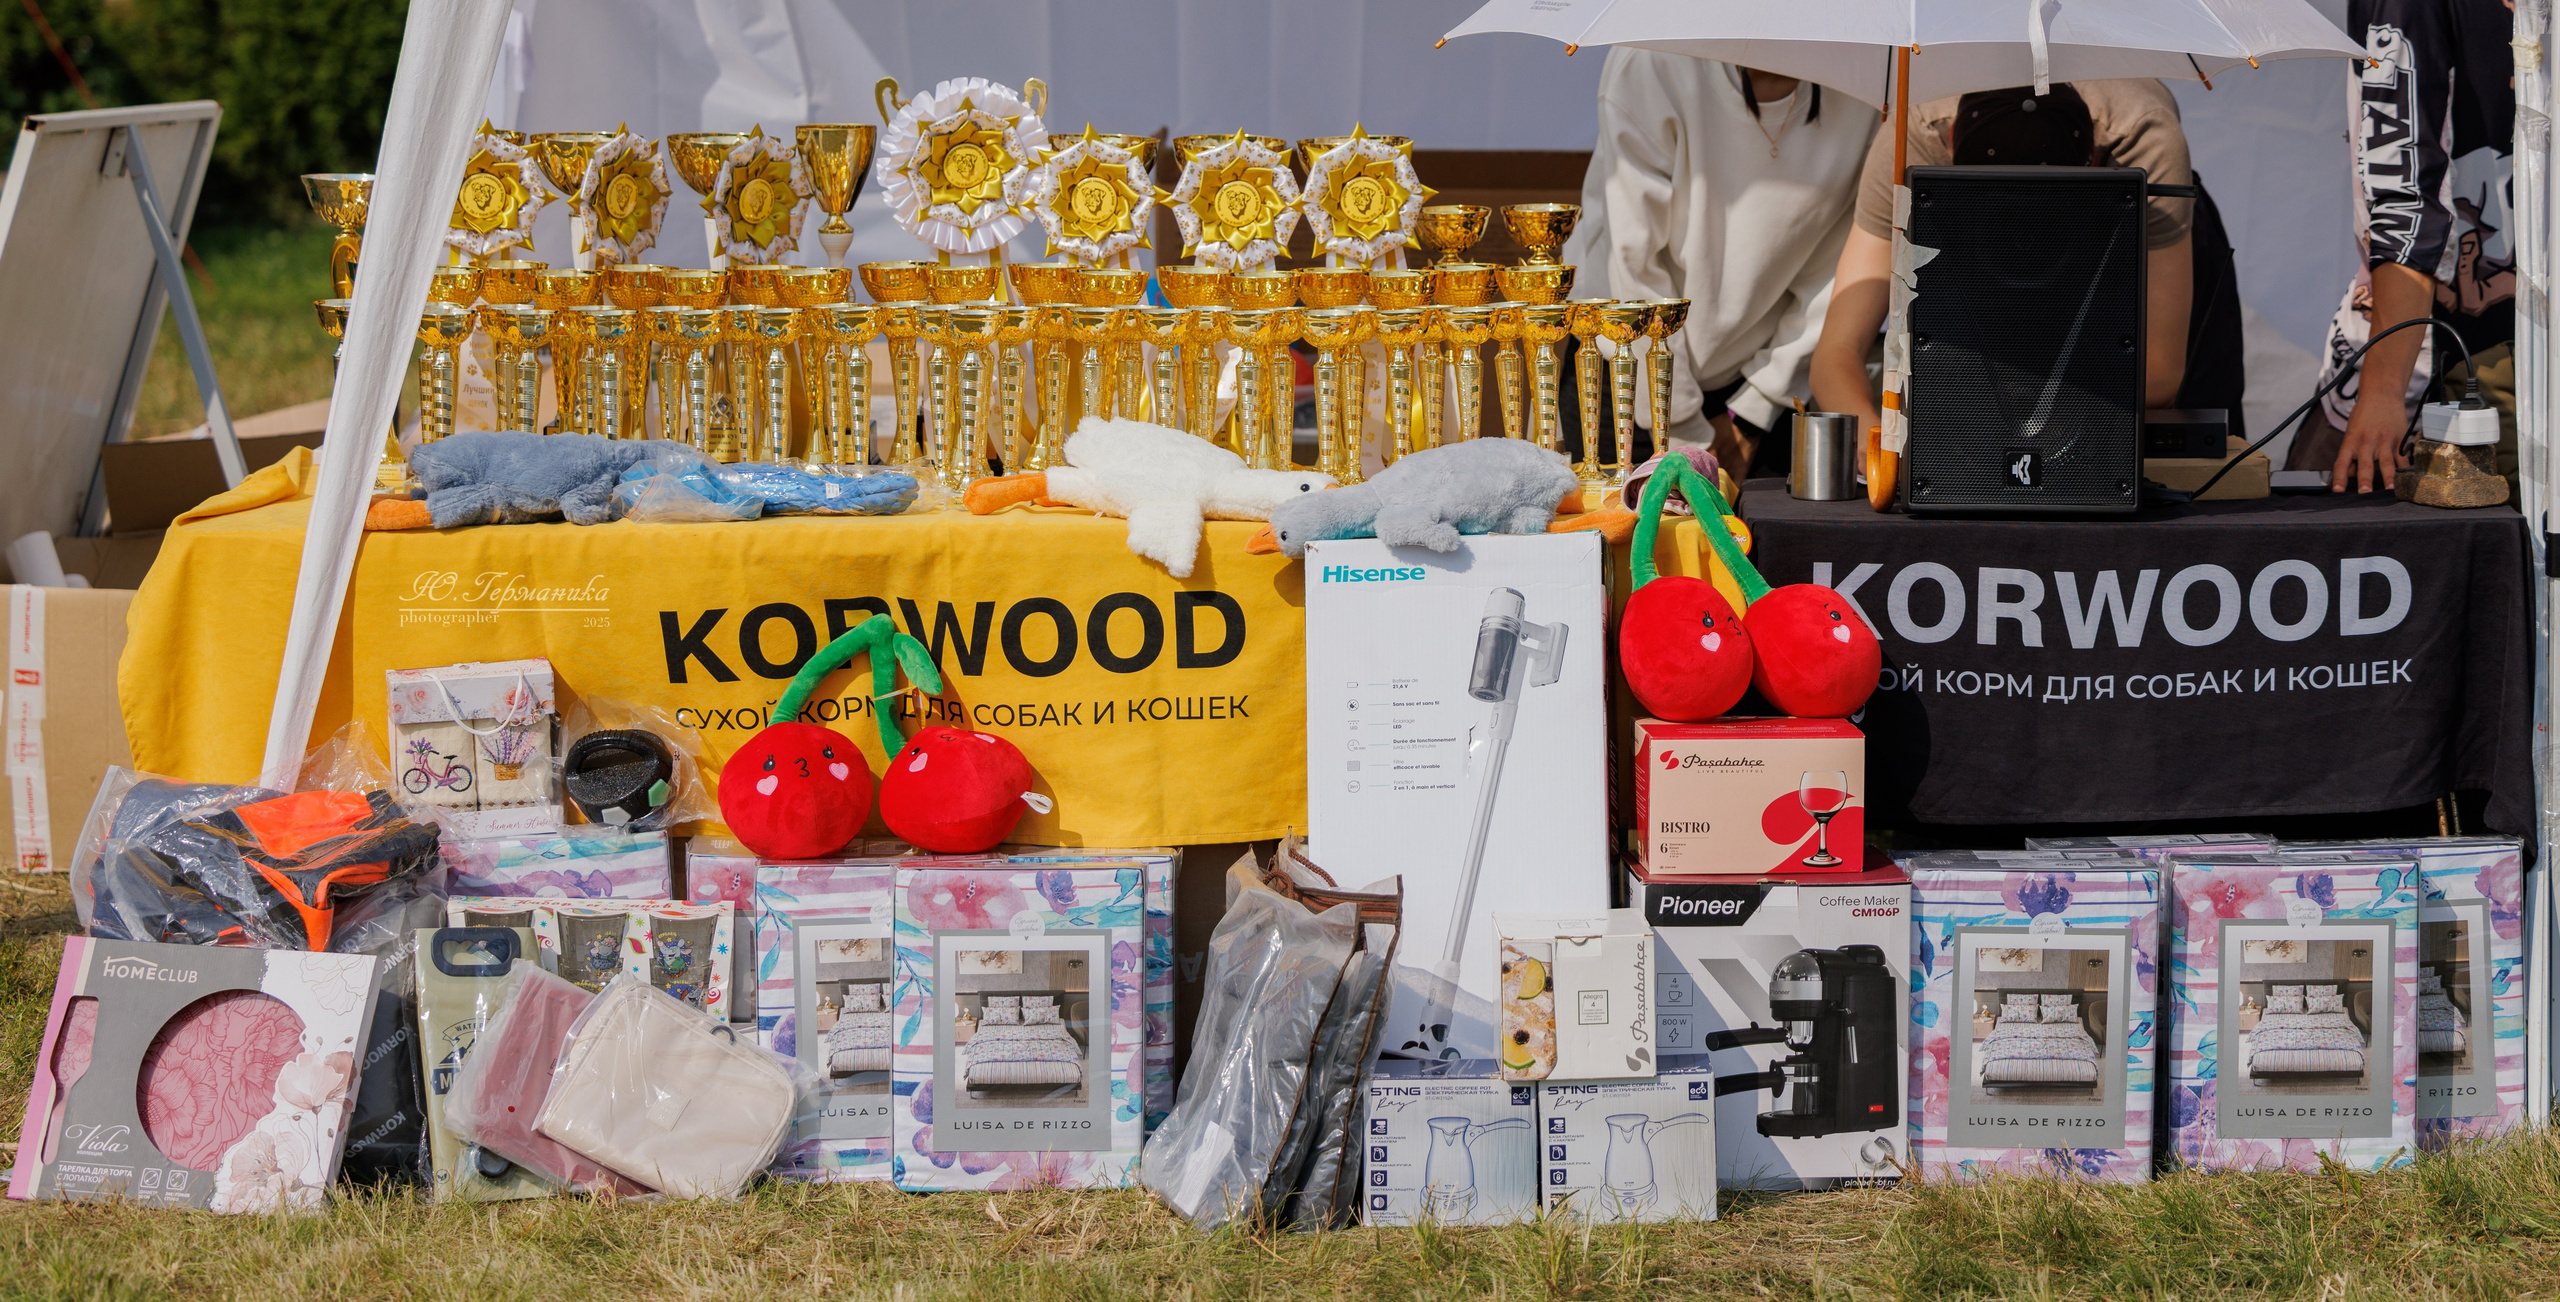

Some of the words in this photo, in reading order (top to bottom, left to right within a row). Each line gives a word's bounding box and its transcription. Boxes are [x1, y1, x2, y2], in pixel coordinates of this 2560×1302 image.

[1323, 565, 1425, 583] Hisense
[1813, 556, 2412, 649] KORWOOD
[659, 590, 1247, 684] KORWOOD
[1936, 669, 2033, 698] КОРМ
[2043, 675, 2114, 704] ДЛЯ
[2126, 669, 2243, 699] СОБАК
[2254, 667, 2275, 692] И
[2288, 659, 2412, 690] КОШЕК
[899, 694, 964, 725] ДЛЯ
[973, 702, 1083, 727] СОБАК
[1094, 701, 1114, 725] И
[1128, 695, 1250, 722] КОШЕК
[485, 819, 522, 833] Summer
[1661, 821, 1710, 834] BISTRO
[1660, 843, 1668, 853] 6
[1658, 896, 1745, 916] Pioneer
[1819, 895, 1861, 907] Coffee
[1864, 895, 1900, 906] Maker
[1852, 908, 1900, 918] CM106P
[103, 956, 198, 983] HOMECLUB
[1662, 1018, 1677, 1026] 800
[362, 1022, 413, 1071] KORWOO
[1371, 1086, 1421, 1096] STING
[1512, 1091, 1529, 1100] eco
[1547, 1084, 1598, 1095] STING
[1690, 1086, 1707, 1095] eco
[2429, 1087, 2477, 1097] RIZZO
[819, 1107, 869, 1118] LUISA
[878, 1106, 889, 1116] D
[2237, 1108, 2287, 1117] LUISA
[2296, 1108, 2316, 1116] DE
[2325, 1107, 2373, 1116] RIZZO
[954, 1121, 1005, 1130] LUISA
[1014, 1120, 1035, 1129] DE
[1043, 1120, 1092, 1129] RIZZO
[1969, 1117, 2019, 1126] LUISA
[2028, 1117, 2049, 1126] DE
[2057, 1118, 2106, 1127] RIZZO
[65, 1124, 131, 1153] Viola
[58, 1164, 91, 1174] ТАРЕЛКА
[91, 1168, 108, 1176] ДЛЯ
[109, 1168, 132, 1177] ТОРТА
[62, 1174, 104, 1183] ЛОПАТКОЙ
